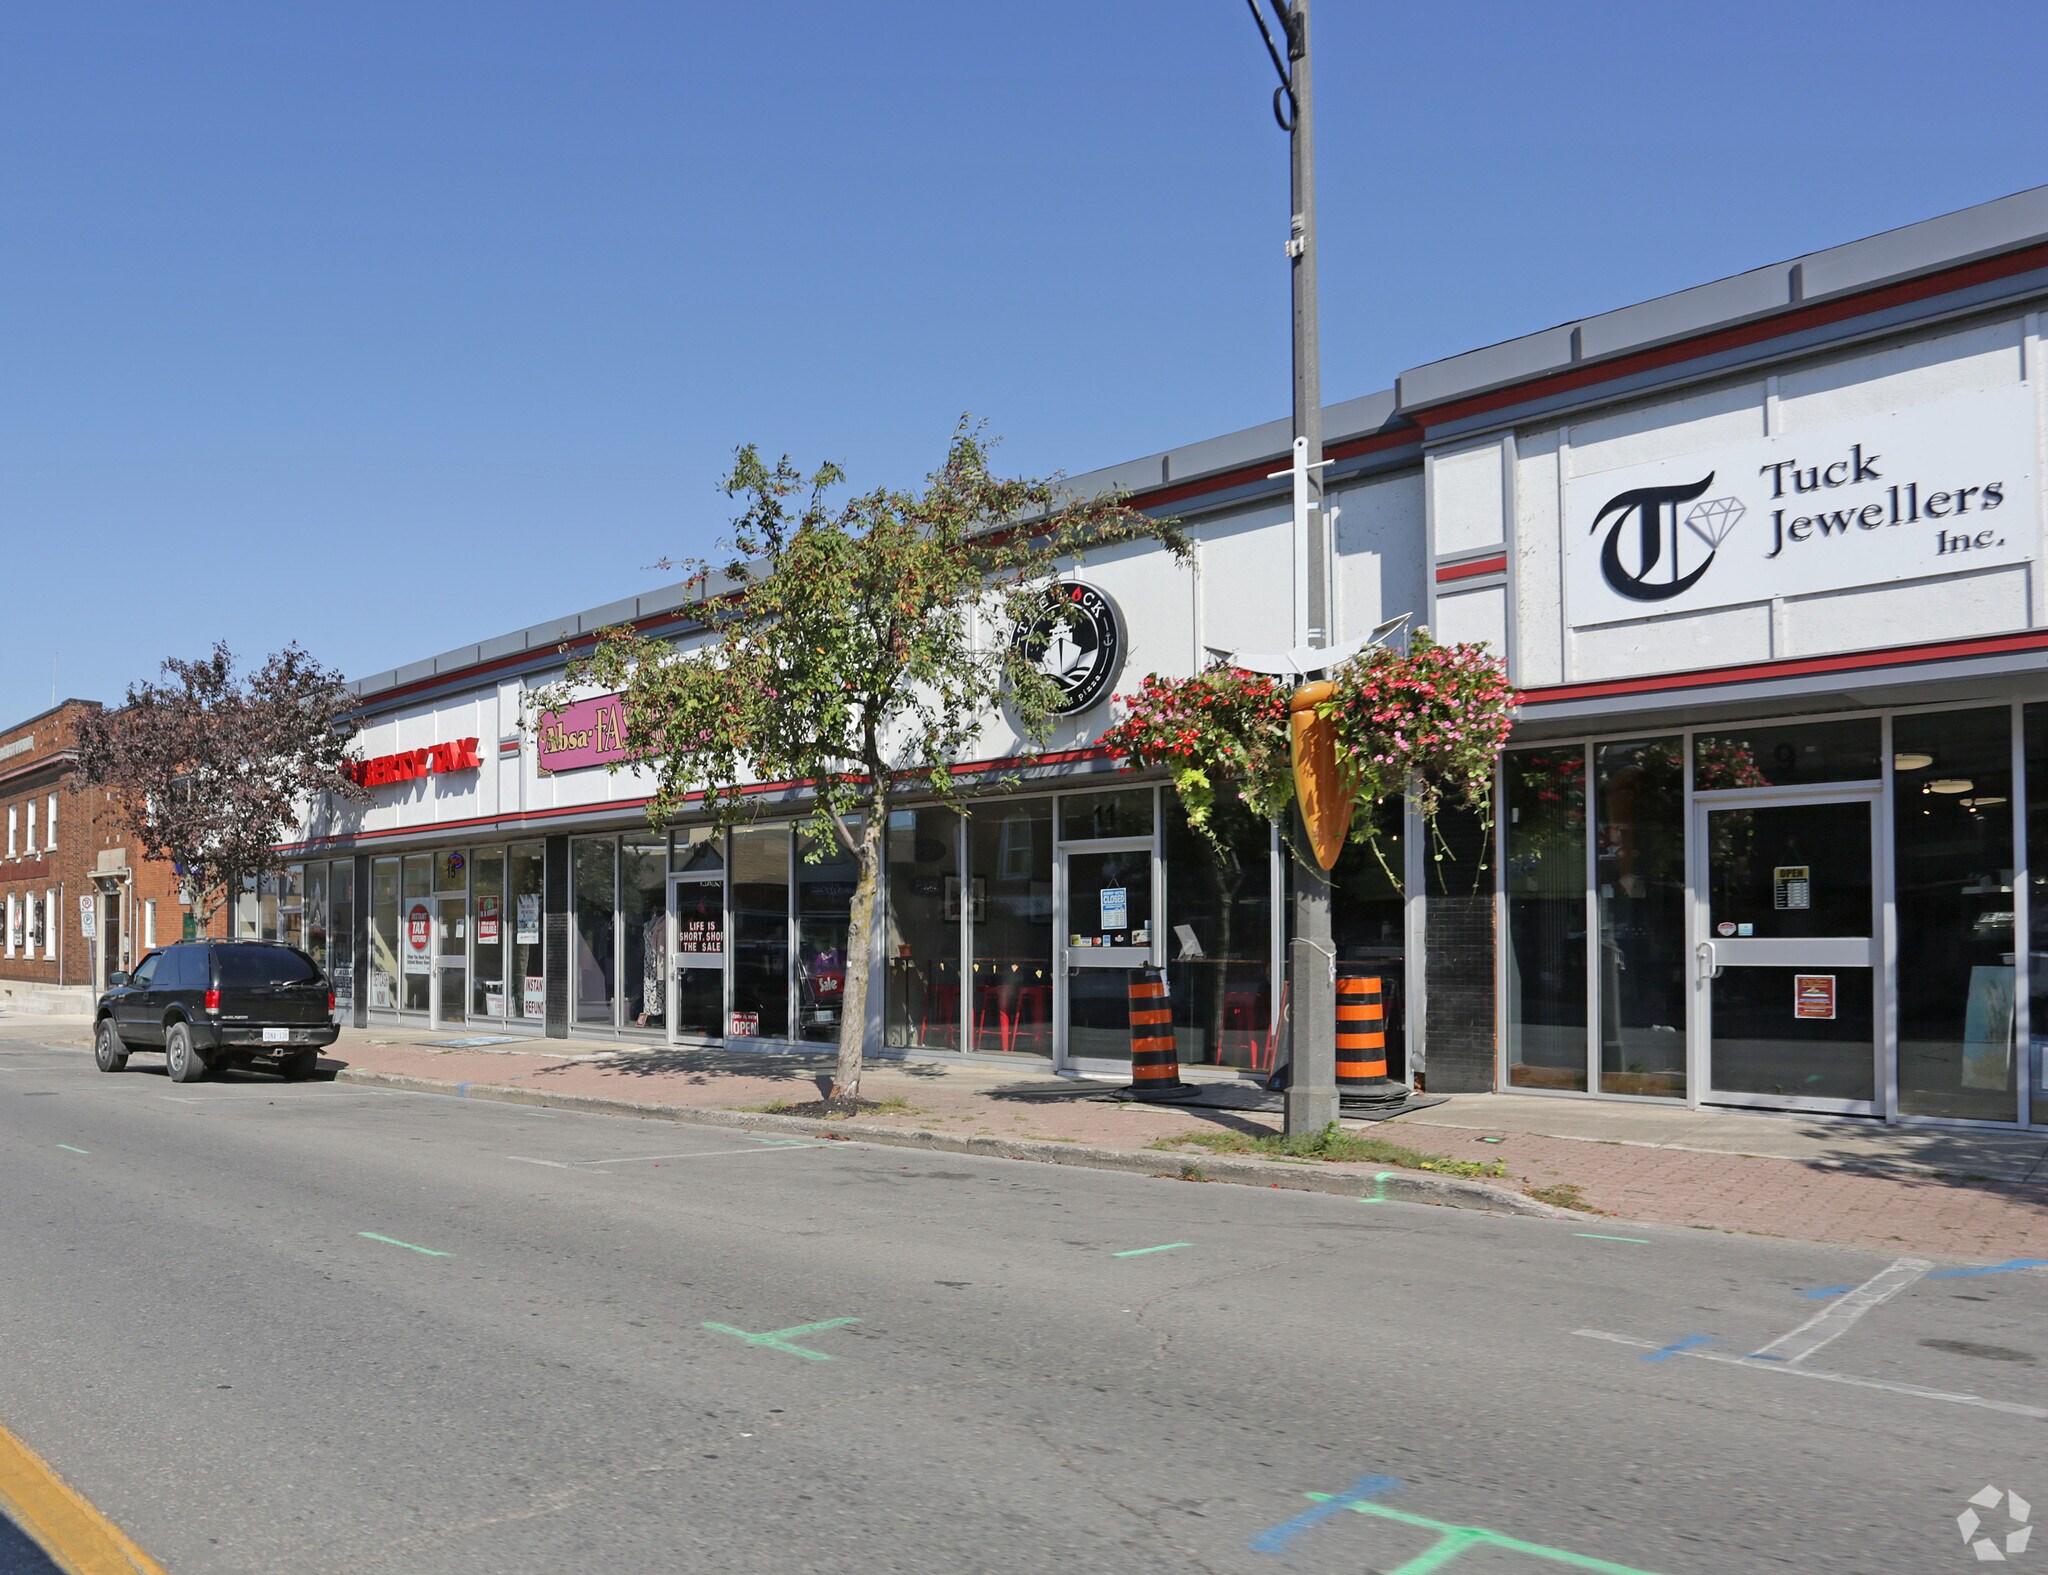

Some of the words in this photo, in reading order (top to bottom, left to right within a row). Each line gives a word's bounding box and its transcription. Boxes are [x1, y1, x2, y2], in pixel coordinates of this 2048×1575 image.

[1759, 443, 1884, 501] Tuck
[1764, 480, 2005, 559] Jewellers
[1935, 529, 2006, 557] Inc.
[1078, 674, 1102, 702] pizza
[428, 736, 480, 774] TAX
[1775, 743, 1797, 769] 9
[1094, 804, 1115, 827] 11
[1780, 868, 1804, 878] OPEN
[1104, 895, 1125, 904] CLOSED
[412, 921, 426, 935] TAX
[689, 921, 705, 931] LIFE
[707, 921, 716, 931] IS
[683, 942, 697, 952] THE
[702, 942, 721, 952] SALE
[525, 978, 543, 992] INSTAN
[818, 976, 838, 993] Sale
[733, 1020, 757, 1035] OPEN
